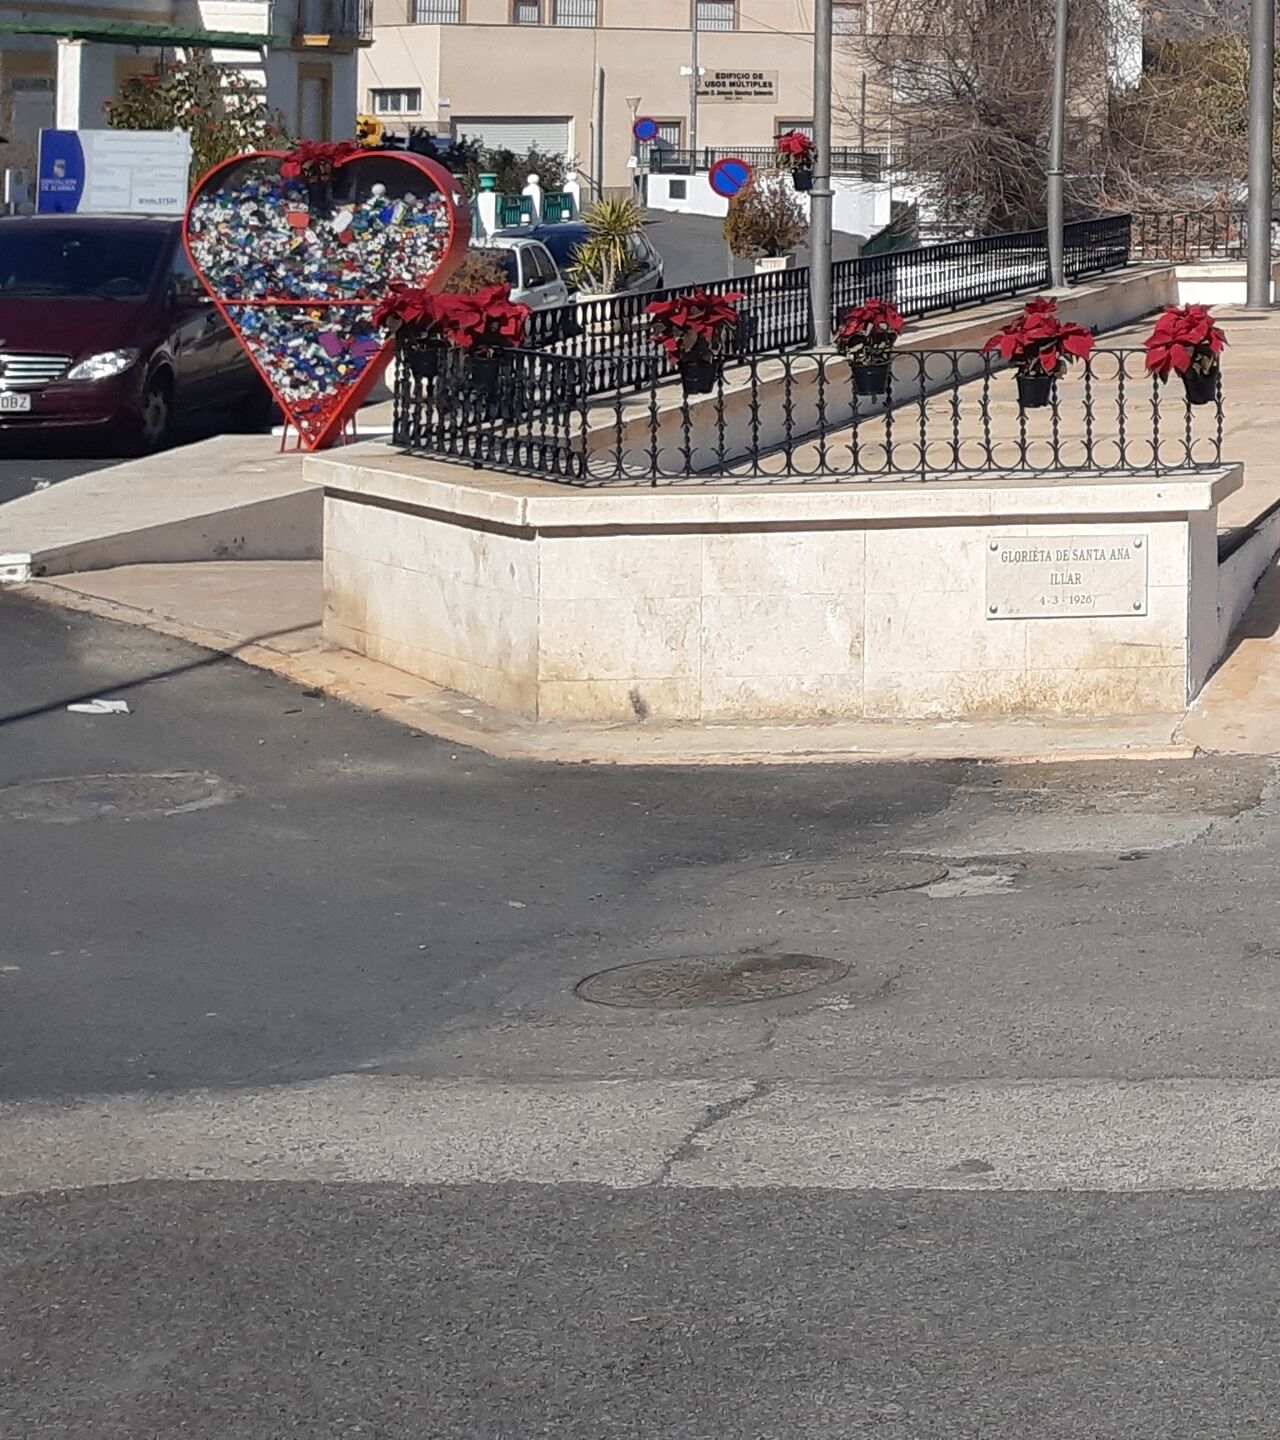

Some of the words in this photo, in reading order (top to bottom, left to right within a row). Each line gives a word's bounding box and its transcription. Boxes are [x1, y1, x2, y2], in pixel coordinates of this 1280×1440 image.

[1001, 550, 1052, 563] GLORIETA
[1056, 549, 1070, 561] DE
[1072, 548, 1106, 561] SANTA
[1109, 547, 1131, 560] ANA
[1050, 572, 1082, 585] ILLAR
